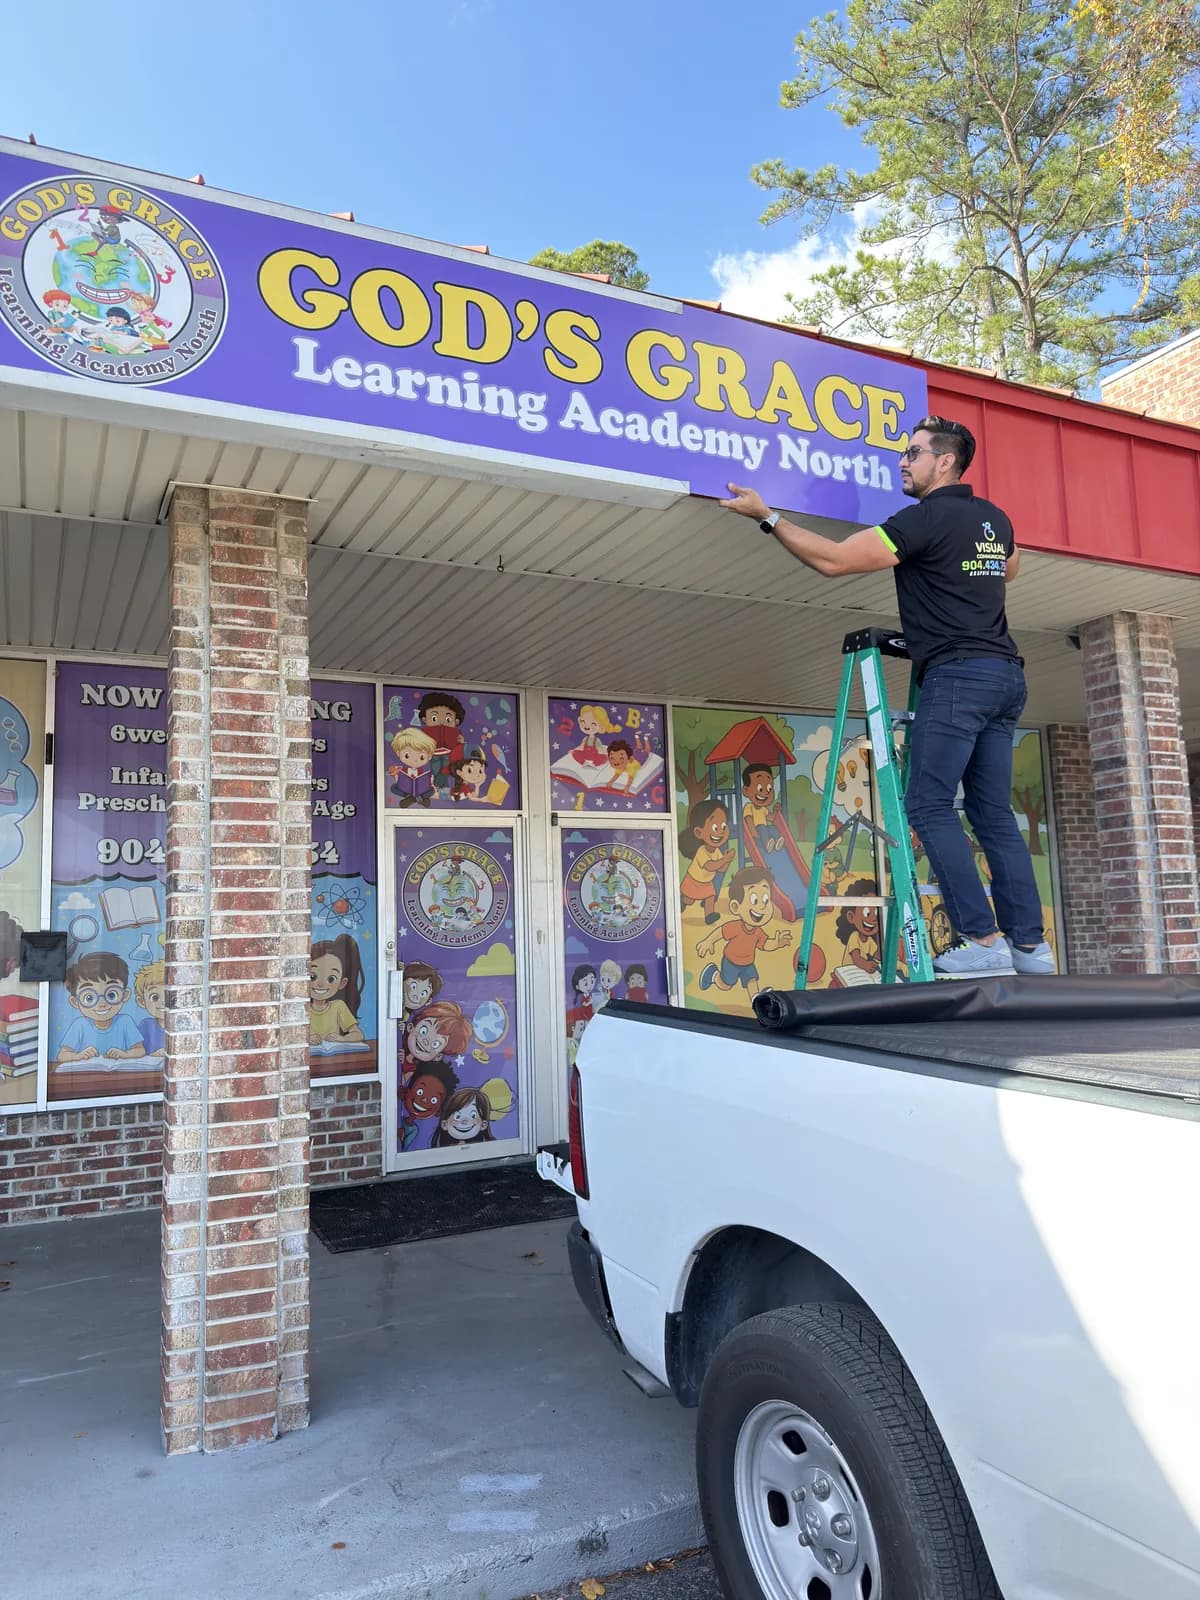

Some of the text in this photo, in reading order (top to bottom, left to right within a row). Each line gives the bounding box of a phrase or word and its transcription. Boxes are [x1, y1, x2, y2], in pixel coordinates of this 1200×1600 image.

[0, 182, 216, 281] GOD'S GRACE
[0, 267, 218, 378] Learning Academy North
[257, 247, 909, 453] GOD'S GRACE
[290, 336, 894, 491] Learning Academy North
[974, 541, 1006, 554] VISUAL
[80, 683, 163, 709] NOW
[110, 724, 168, 743] 6we
[111, 766, 168, 786] Infa
[312, 799, 356, 820] Age
[97, 838, 166, 864] 904
[409, 845, 504, 885] GOD'S GRACE
[571, 846, 656, 883] GOD'S GRACE
[407, 898, 505, 944] Learning Academy North
[570, 895, 657, 938] Learning Academy North
